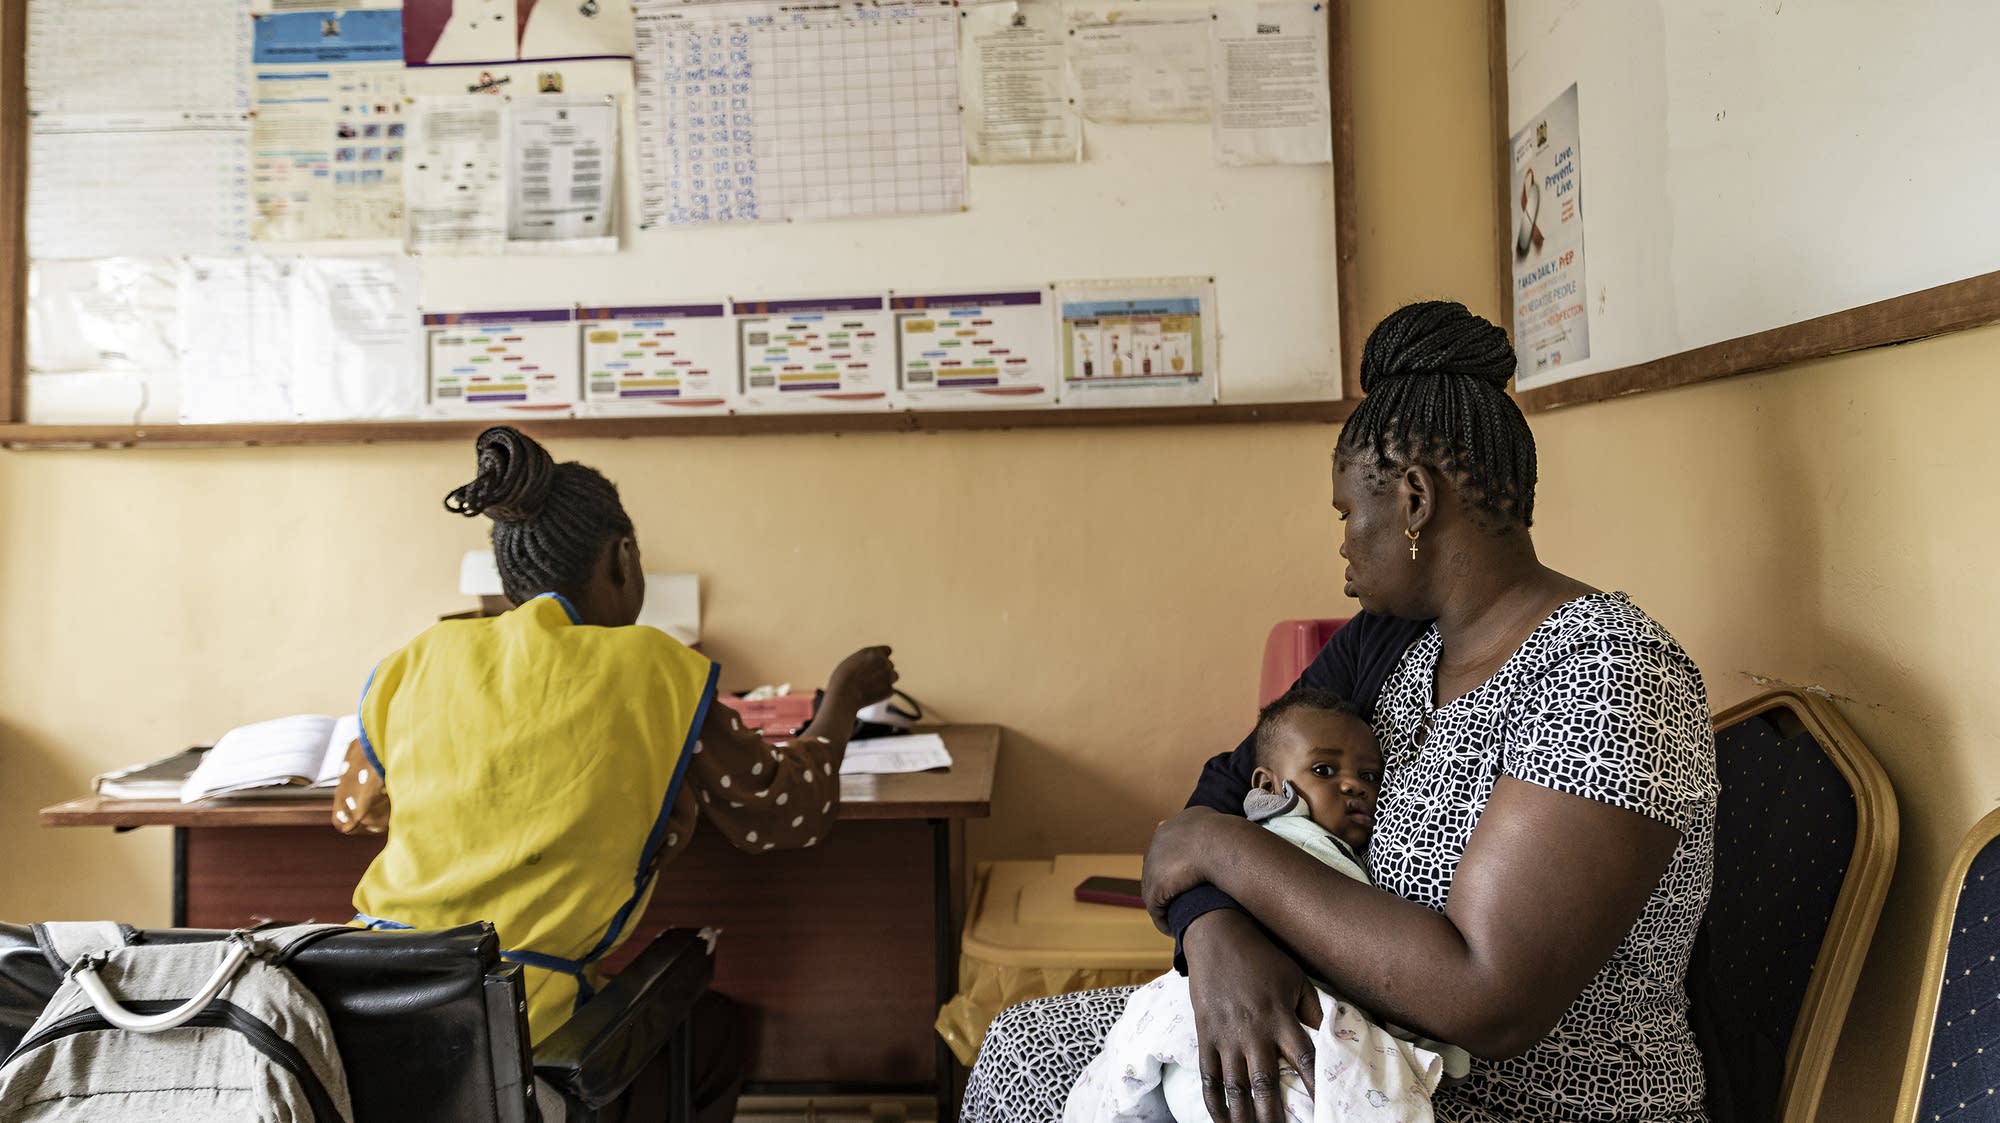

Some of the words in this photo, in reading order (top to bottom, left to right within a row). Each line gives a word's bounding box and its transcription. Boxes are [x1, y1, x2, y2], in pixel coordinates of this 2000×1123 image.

[1555, 146, 1573, 167] Love.
[1545, 161, 1574, 190] Prevent.
[1556, 179, 1573, 197] Live.
[1518, 272, 1537, 289] TAKEN
[1553, 280, 1576, 300] PEOPLE
